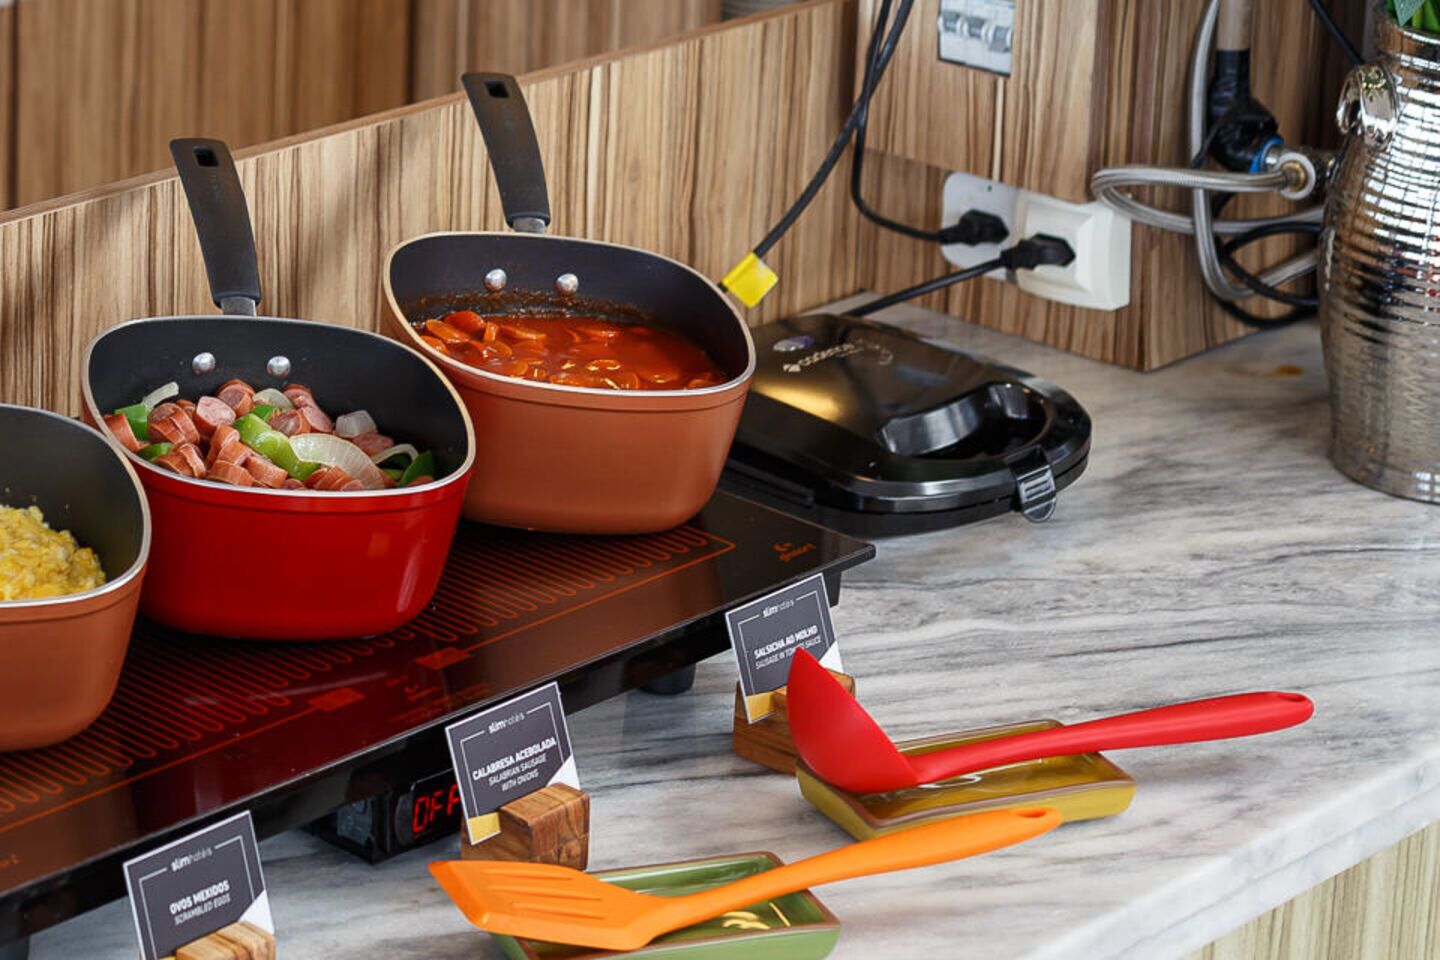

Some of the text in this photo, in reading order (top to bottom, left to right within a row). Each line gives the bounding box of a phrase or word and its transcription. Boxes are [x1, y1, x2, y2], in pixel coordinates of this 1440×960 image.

[754, 625, 818, 659] SALSICHA AO MOLHO
[472, 737, 557, 781] CALABRESA ACEBOLADA
[520, 753, 547, 772] SAUSAGE
[501, 768, 539, 792] WITH ONIONS
[413, 783, 461, 833] OFF
[169, 880, 231, 915] OVOS MEXIDOS
[174, 902, 213, 925] SCRAMBLED
